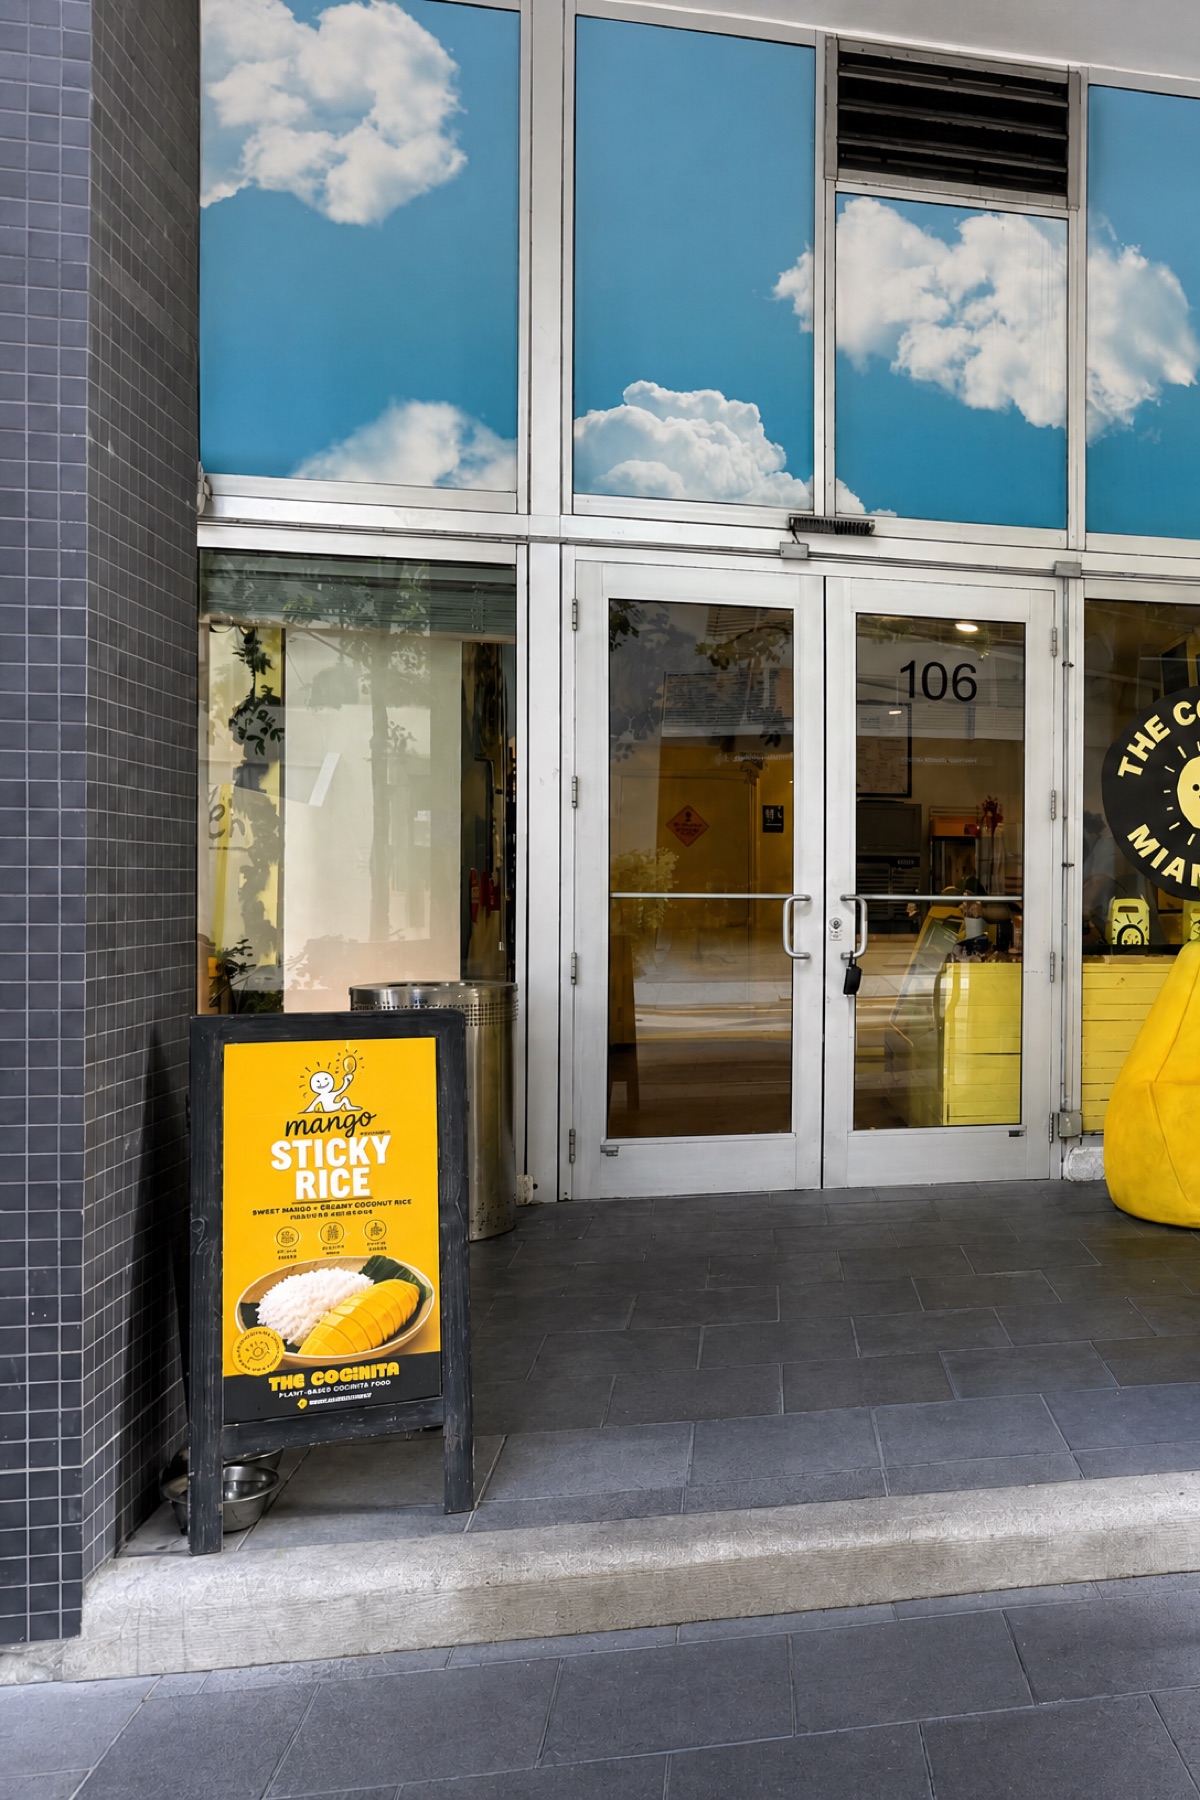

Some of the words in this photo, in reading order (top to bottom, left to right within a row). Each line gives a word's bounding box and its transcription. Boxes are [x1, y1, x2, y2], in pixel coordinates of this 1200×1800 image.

[899, 659, 978, 702] 106
[1117, 714, 1171, 778] THE
[285, 1112, 376, 1139] mango
[271, 1135, 392, 1170] STICKY
[296, 1167, 371, 1200] RICE
[252, 1208, 280, 1216] SWEET
[354, 1200, 392, 1208] COCONUT
[268, 1373, 305, 1392] THE
[310, 1362, 399, 1385] COCINITA
